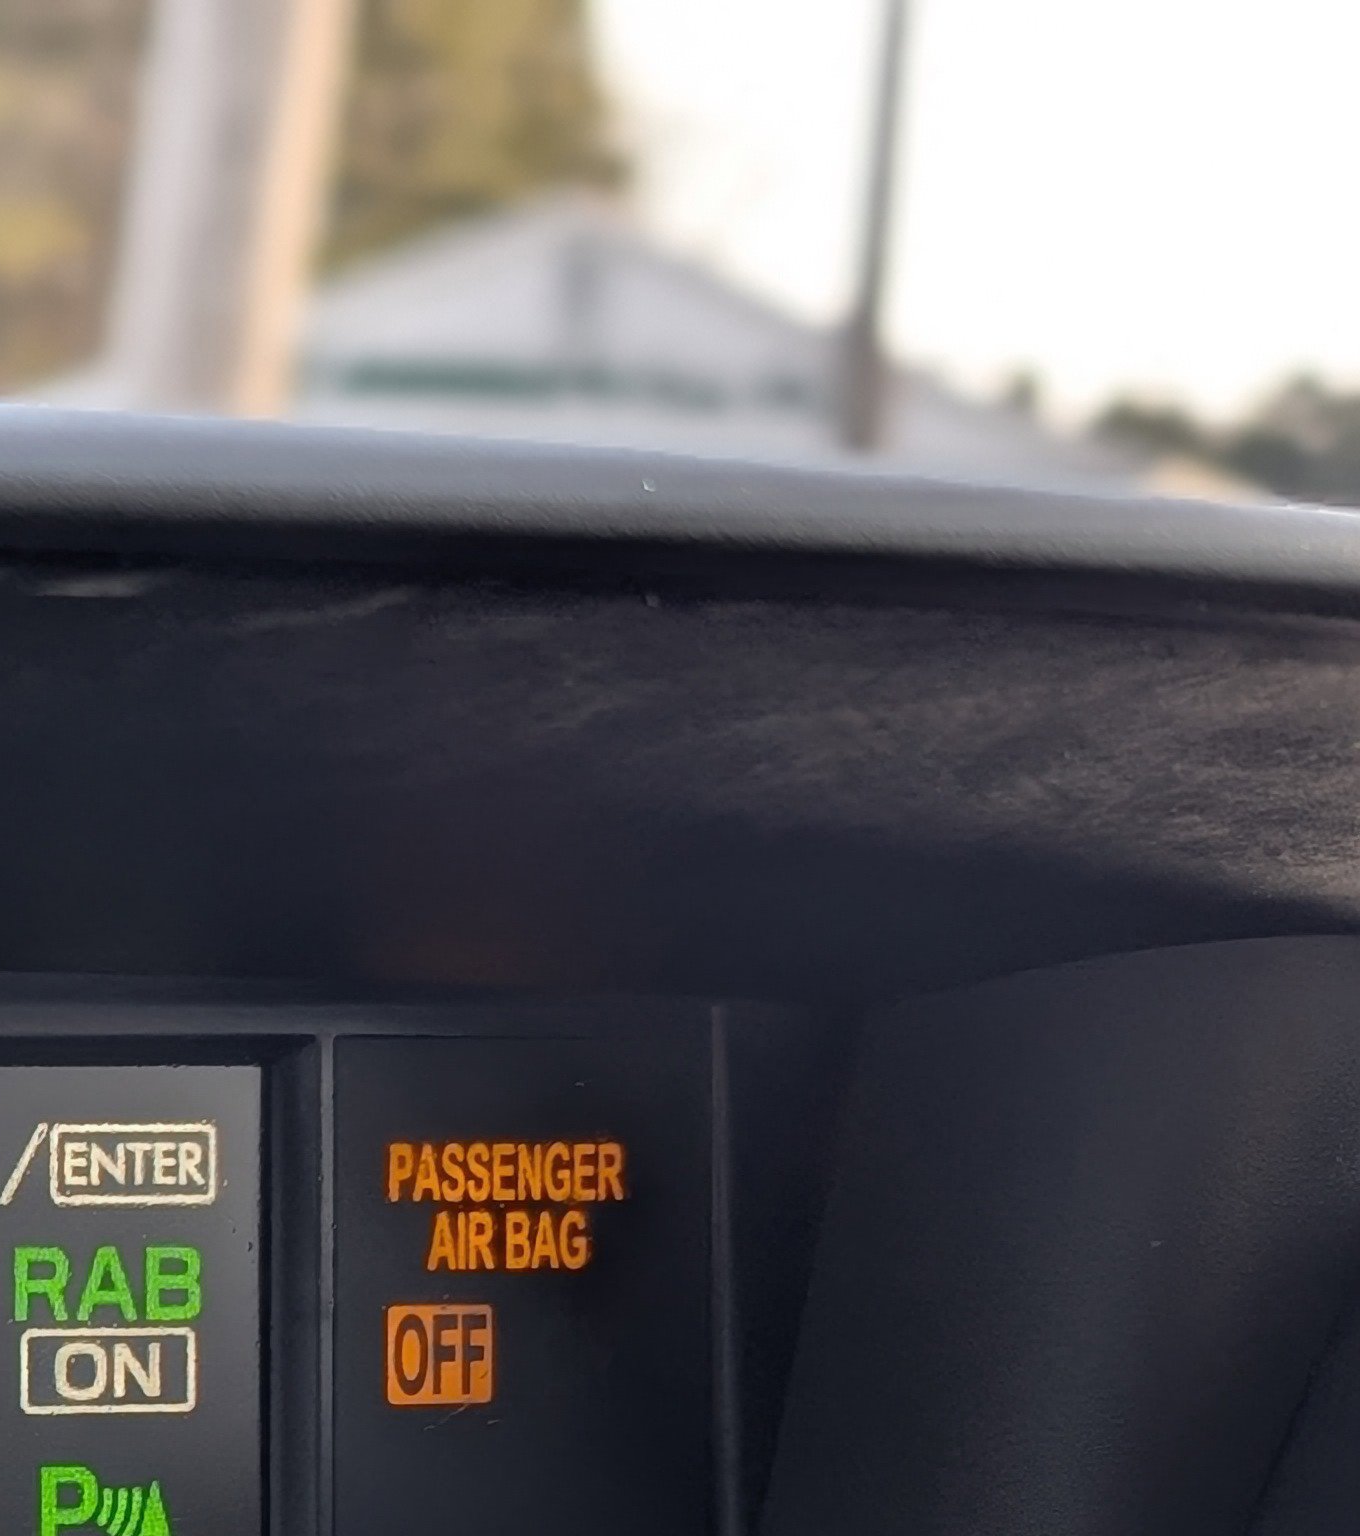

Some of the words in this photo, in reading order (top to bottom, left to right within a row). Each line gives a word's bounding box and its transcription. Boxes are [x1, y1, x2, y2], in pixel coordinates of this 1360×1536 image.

[62, 1140, 207, 1187] ENTER
[387, 1142, 624, 1203] PASSENGER
[427, 1212, 495, 1271] AIR
[505, 1210, 589, 1271] BAG
[13, 1246, 203, 1322] RAB
[54, 1342, 163, 1400] ON
[393, 1313, 488, 1397] OFF
